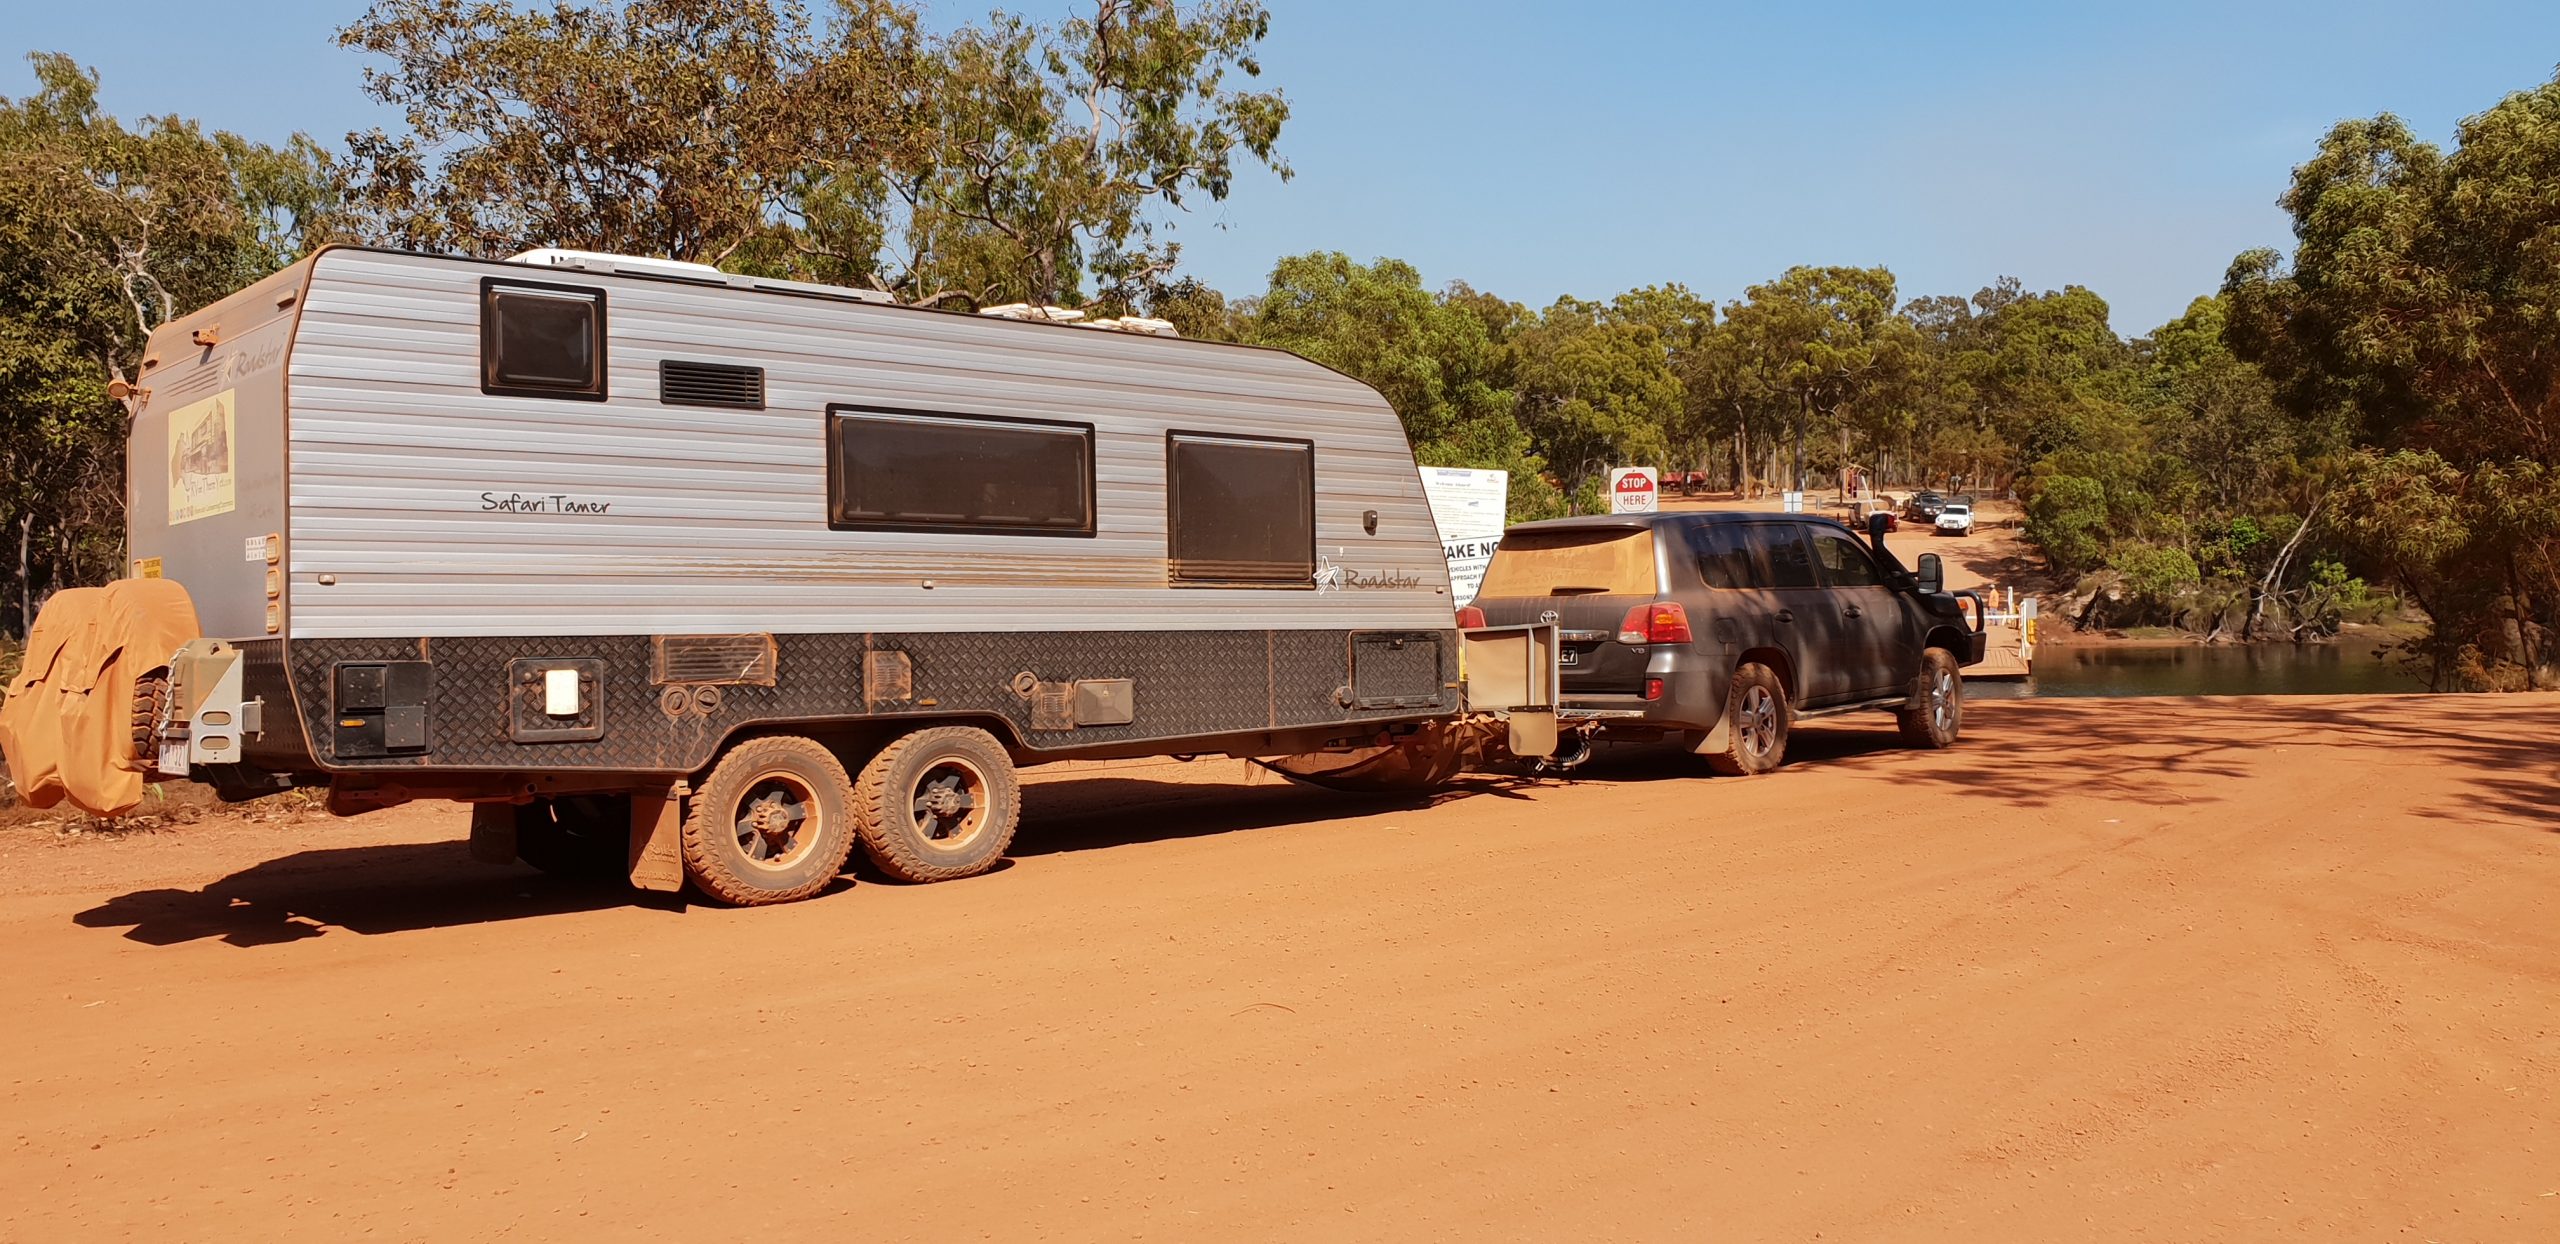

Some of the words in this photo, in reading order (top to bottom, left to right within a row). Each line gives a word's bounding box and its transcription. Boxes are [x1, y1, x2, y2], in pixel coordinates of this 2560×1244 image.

[1621, 477, 1647, 489] STOP
[481, 492, 545, 513] Safari
[549, 495, 610, 513] Tamer
[1623, 494, 1646, 505] HERE
[1442, 543, 1476, 560] AKE
[1343, 568, 1421, 590] Roadstar
[1558, 649, 1576, 663] E7
[1631, 647, 1646, 655] V8
